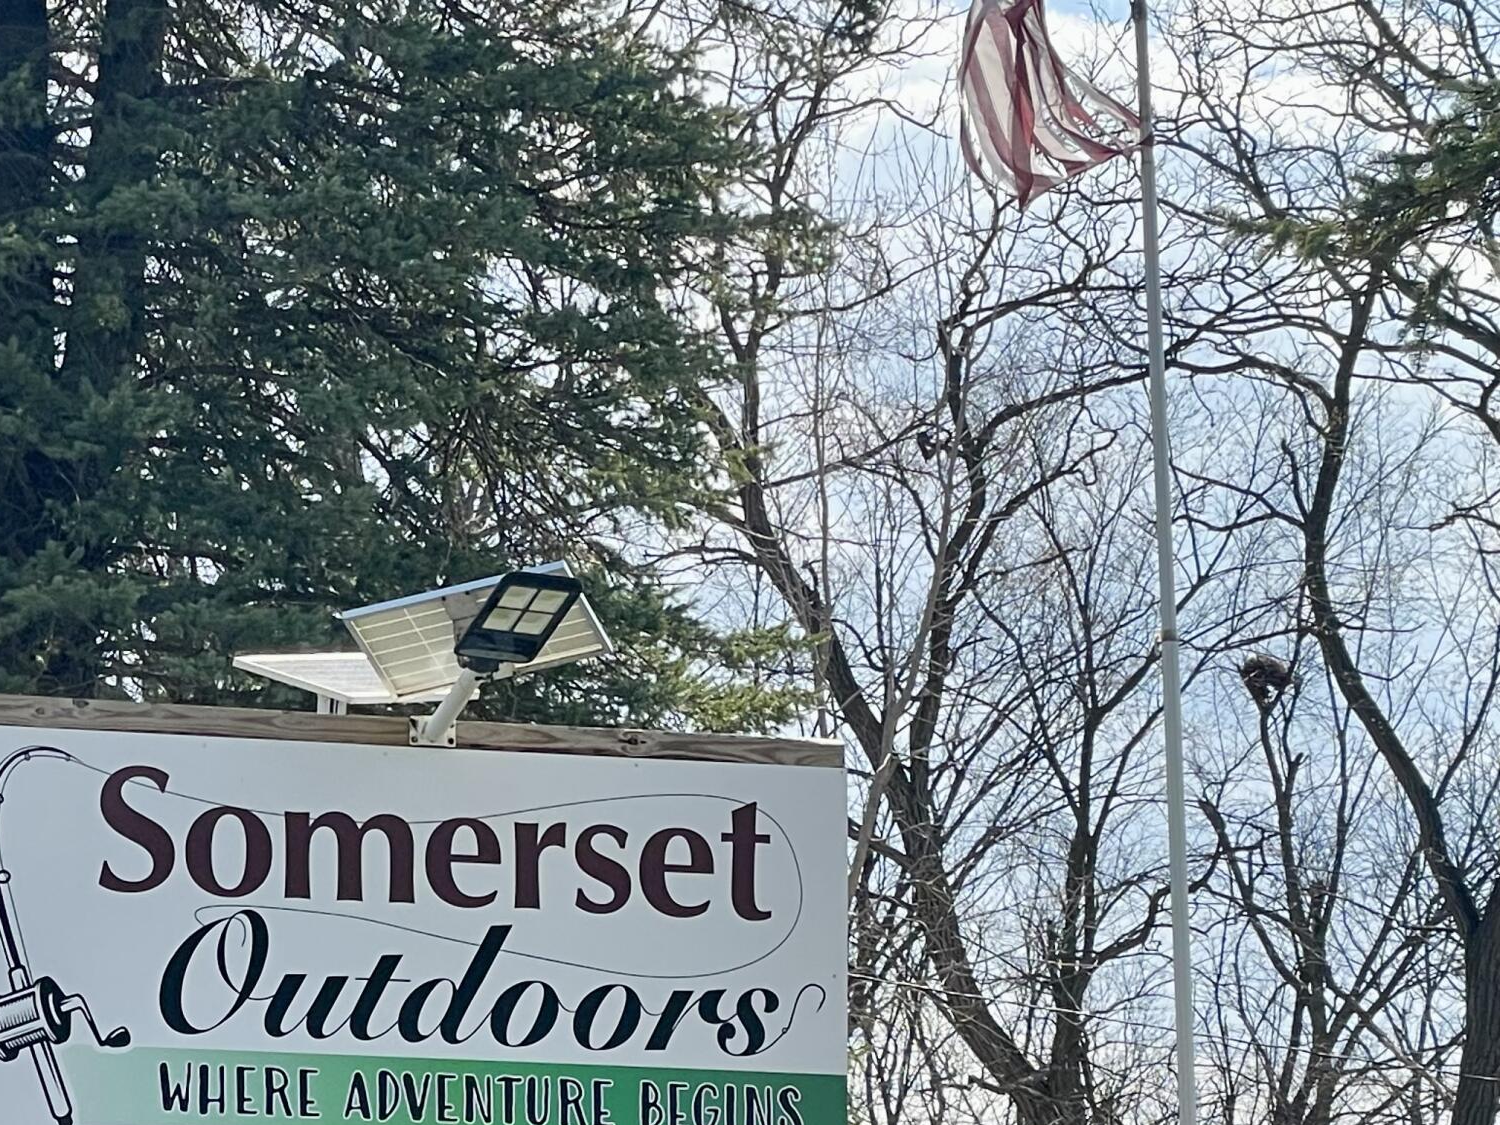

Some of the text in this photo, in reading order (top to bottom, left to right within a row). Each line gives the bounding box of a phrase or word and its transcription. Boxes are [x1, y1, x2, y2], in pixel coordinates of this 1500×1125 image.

[98, 765, 772, 922] Somerset
[160, 909, 783, 1057] Outdoors
[159, 1061, 321, 1118] WHERE
